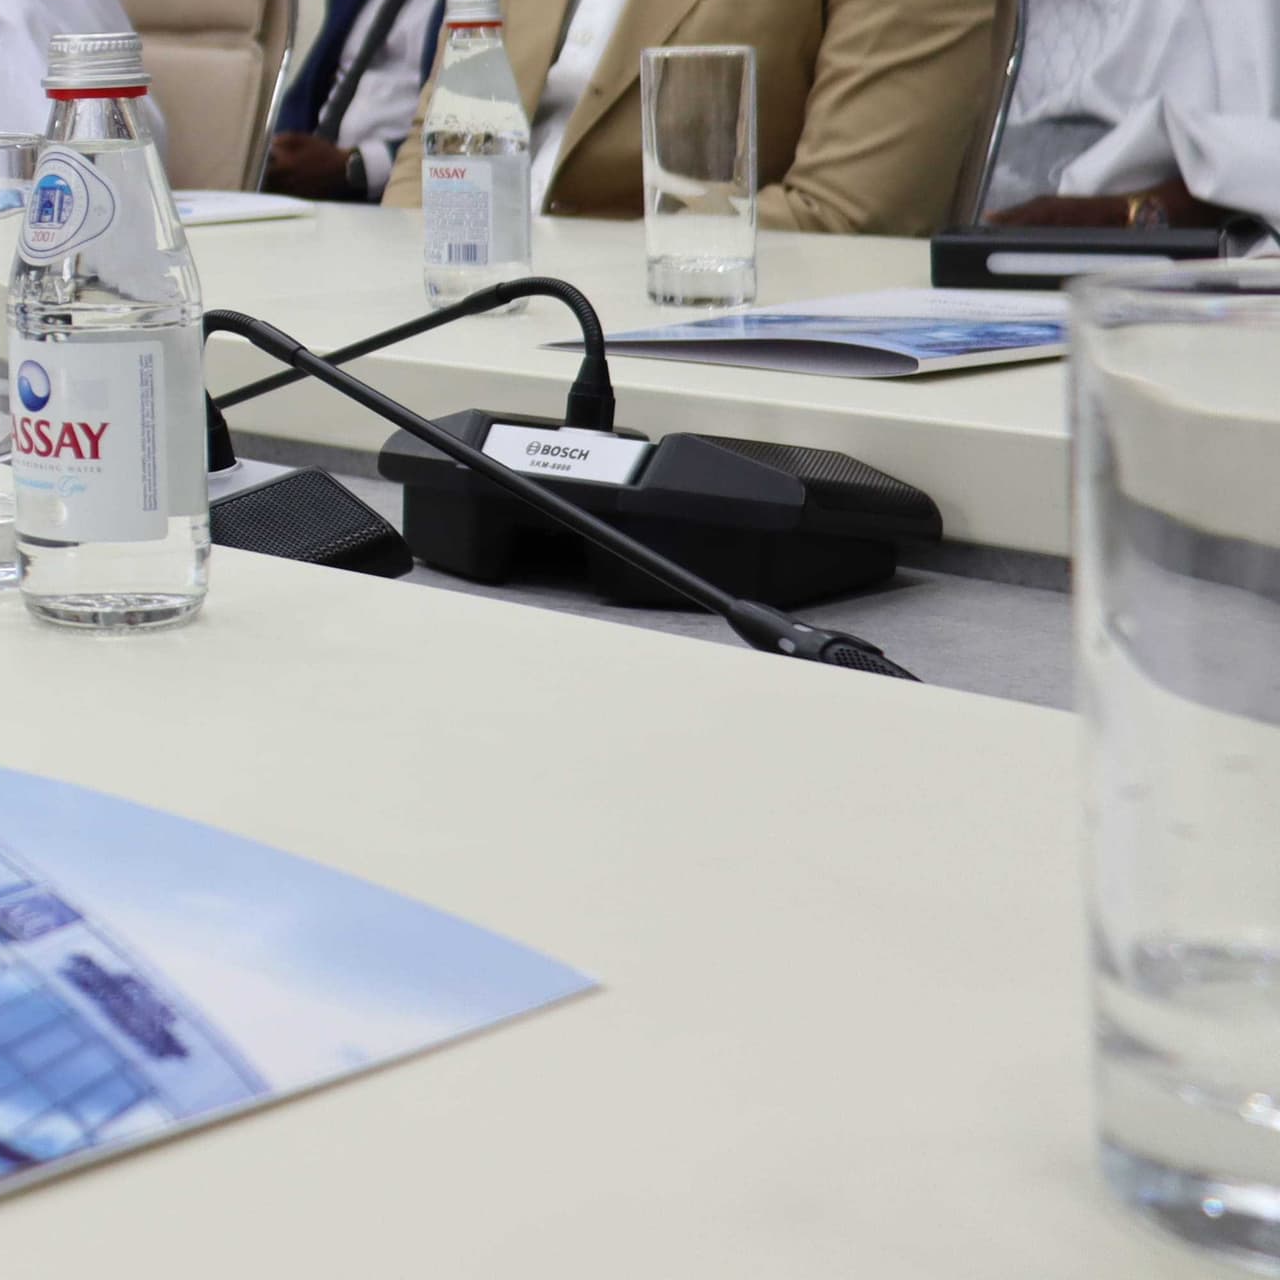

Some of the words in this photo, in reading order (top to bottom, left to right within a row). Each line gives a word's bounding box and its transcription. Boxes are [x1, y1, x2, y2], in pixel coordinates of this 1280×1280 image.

[429, 166, 467, 180] TASSAY
[32, 230, 57, 243] 2001
[12, 415, 110, 460] ASSAY
[541, 445, 590, 461] BOSCH
[67, 464, 103, 474] WATER
